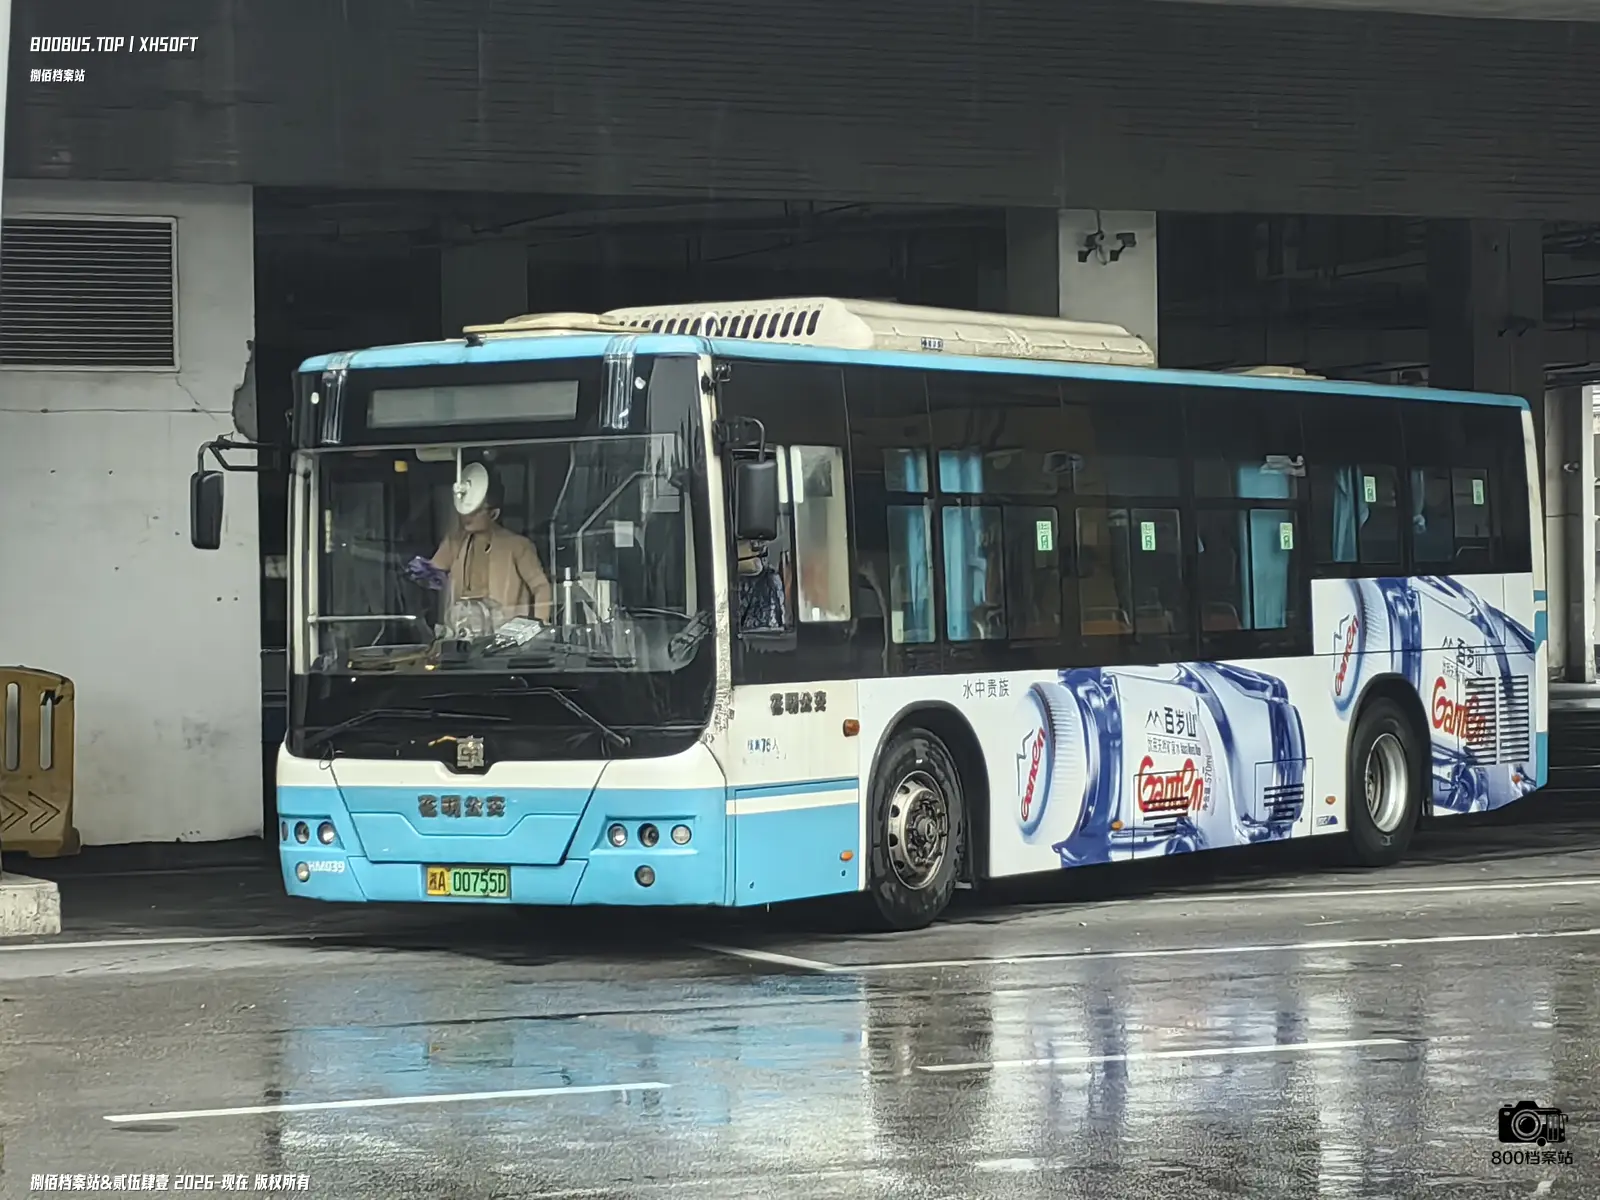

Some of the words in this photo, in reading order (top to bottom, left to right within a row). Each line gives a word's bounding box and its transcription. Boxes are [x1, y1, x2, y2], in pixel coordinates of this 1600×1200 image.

[962, 678, 1010, 699] 水中贵族
[1164, 706, 1198, 737] 百岁山
